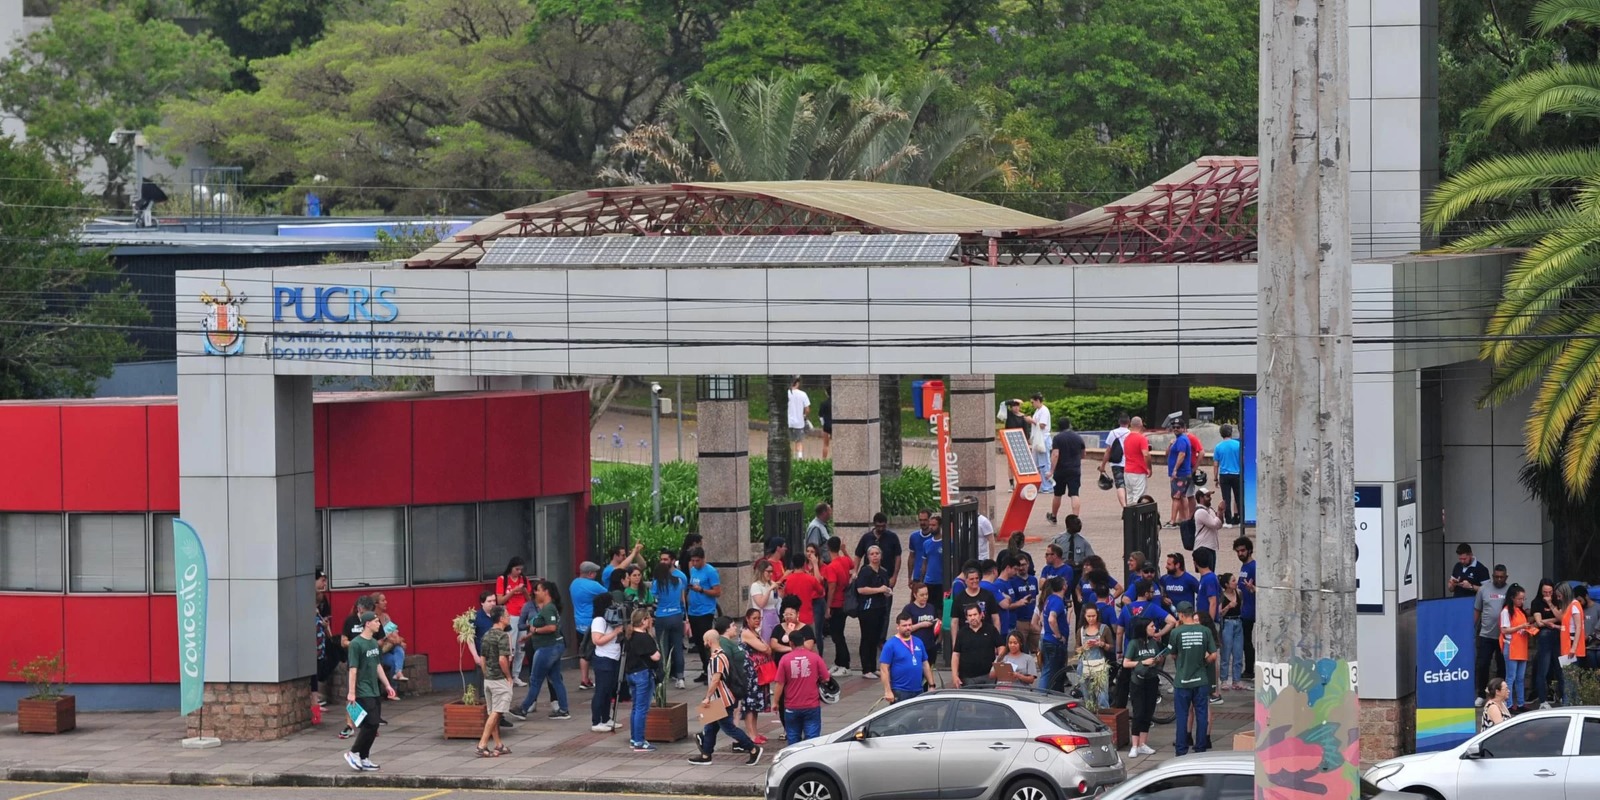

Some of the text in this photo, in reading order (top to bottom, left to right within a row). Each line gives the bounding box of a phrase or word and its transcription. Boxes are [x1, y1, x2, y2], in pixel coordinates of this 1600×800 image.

[273, 286, 398, 323] PUCRS
[349, 330, 444, 344] UNIVERSIDADE
[448, 329, 514, 343] CATÓLICA
[274, 347, 435, 360] DO RIO GRANDE DO SUL
[1404, 533, 1412, 585] 2
[180, 563, 198, 678] conceito
[1263, 667, 1282, 687] 34
[1424, 668, 1469, 683] Estácio
